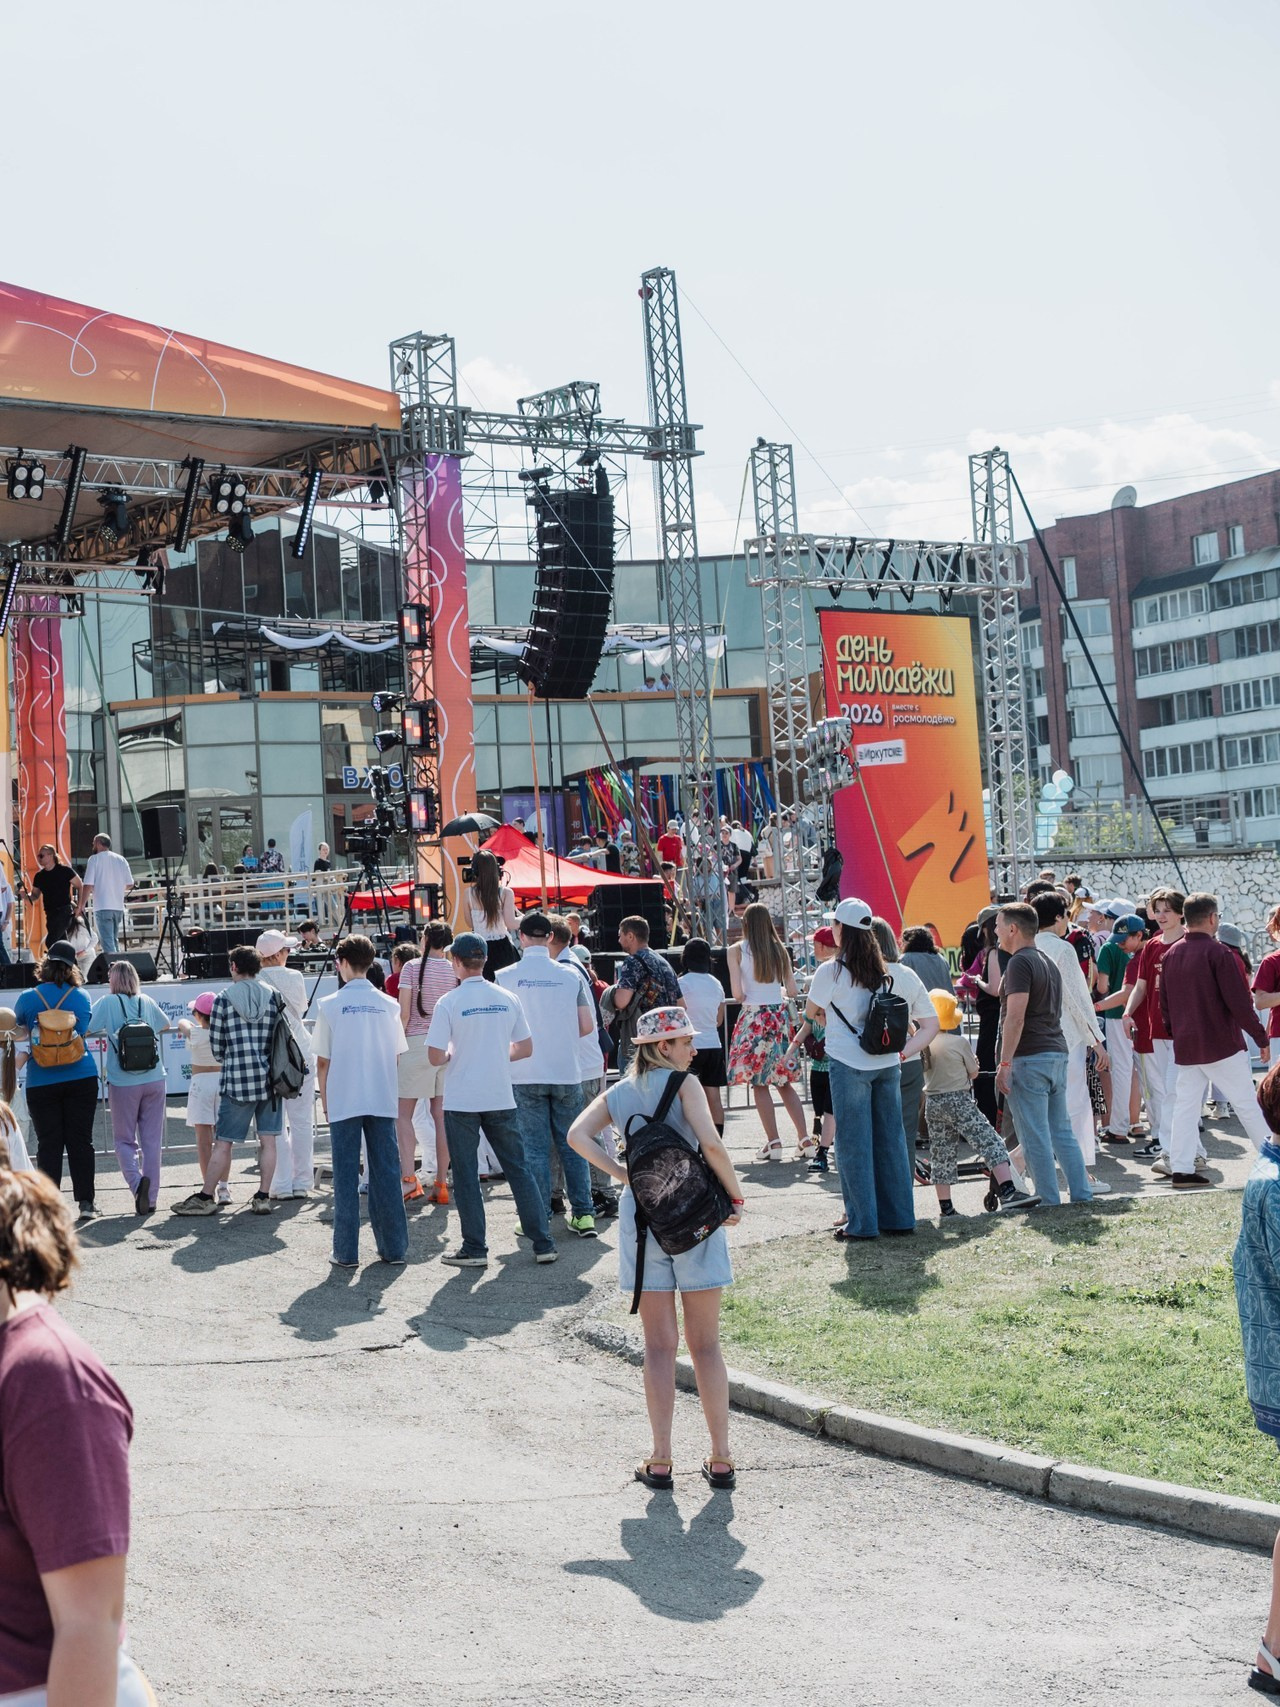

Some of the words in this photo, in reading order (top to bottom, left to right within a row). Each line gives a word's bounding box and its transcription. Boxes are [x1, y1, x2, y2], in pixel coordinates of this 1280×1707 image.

[840, 703, 883, 724] 2026
[893, 714, 955, 726] росмолодёжь
[342, 764, 406, 788] ВХО
